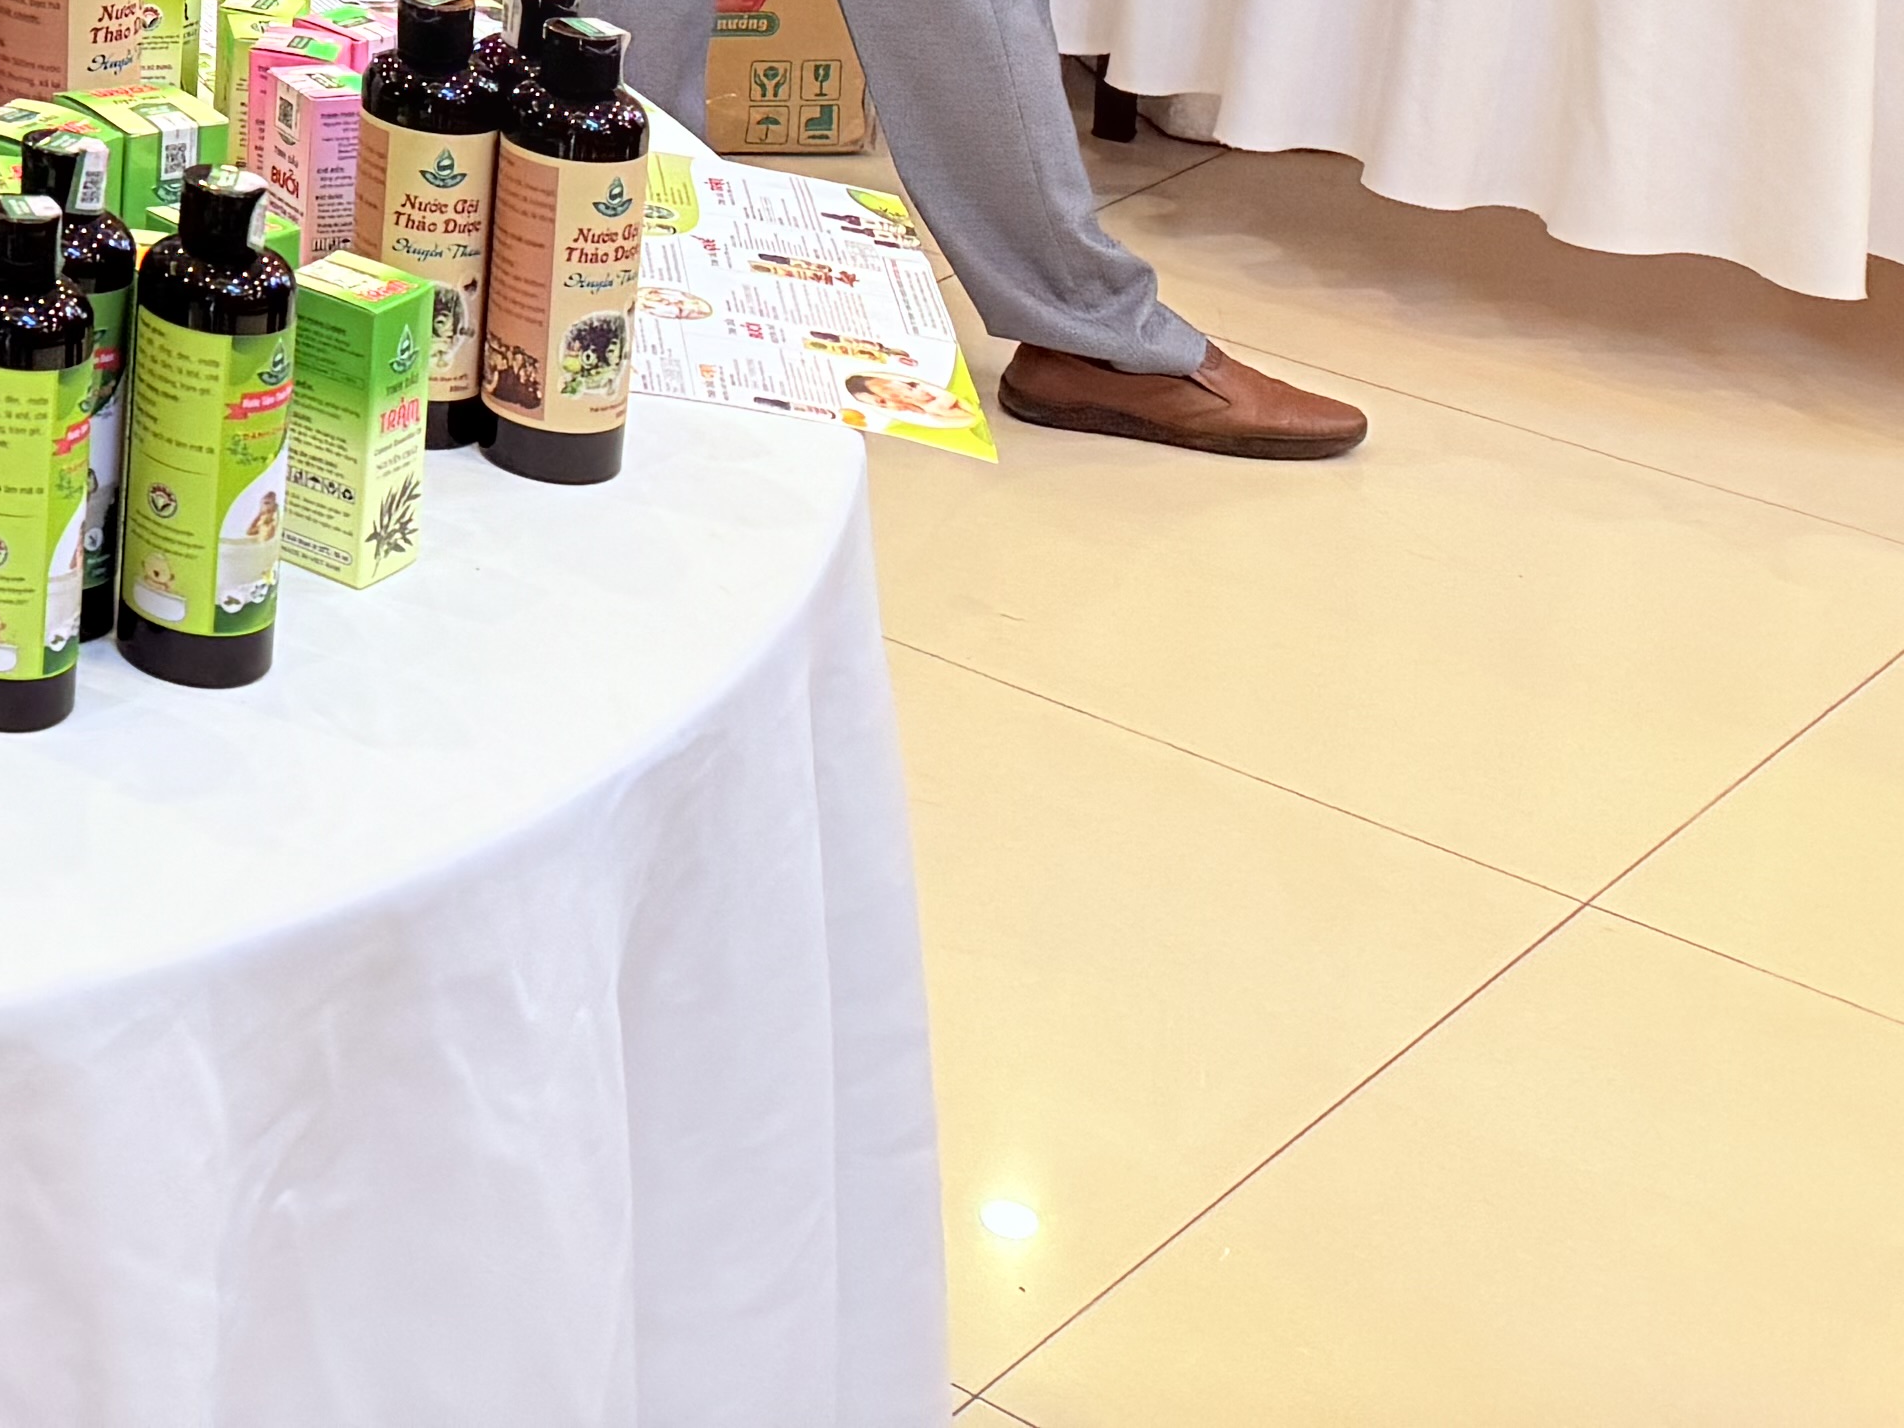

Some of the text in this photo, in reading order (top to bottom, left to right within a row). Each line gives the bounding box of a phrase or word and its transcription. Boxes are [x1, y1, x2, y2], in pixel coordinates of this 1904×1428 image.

[270, 165, 300, 199] BƯỞI
[400, 193, 479, 219] Nước Gội
[393, 211, 482, 237] Thảo Dược
